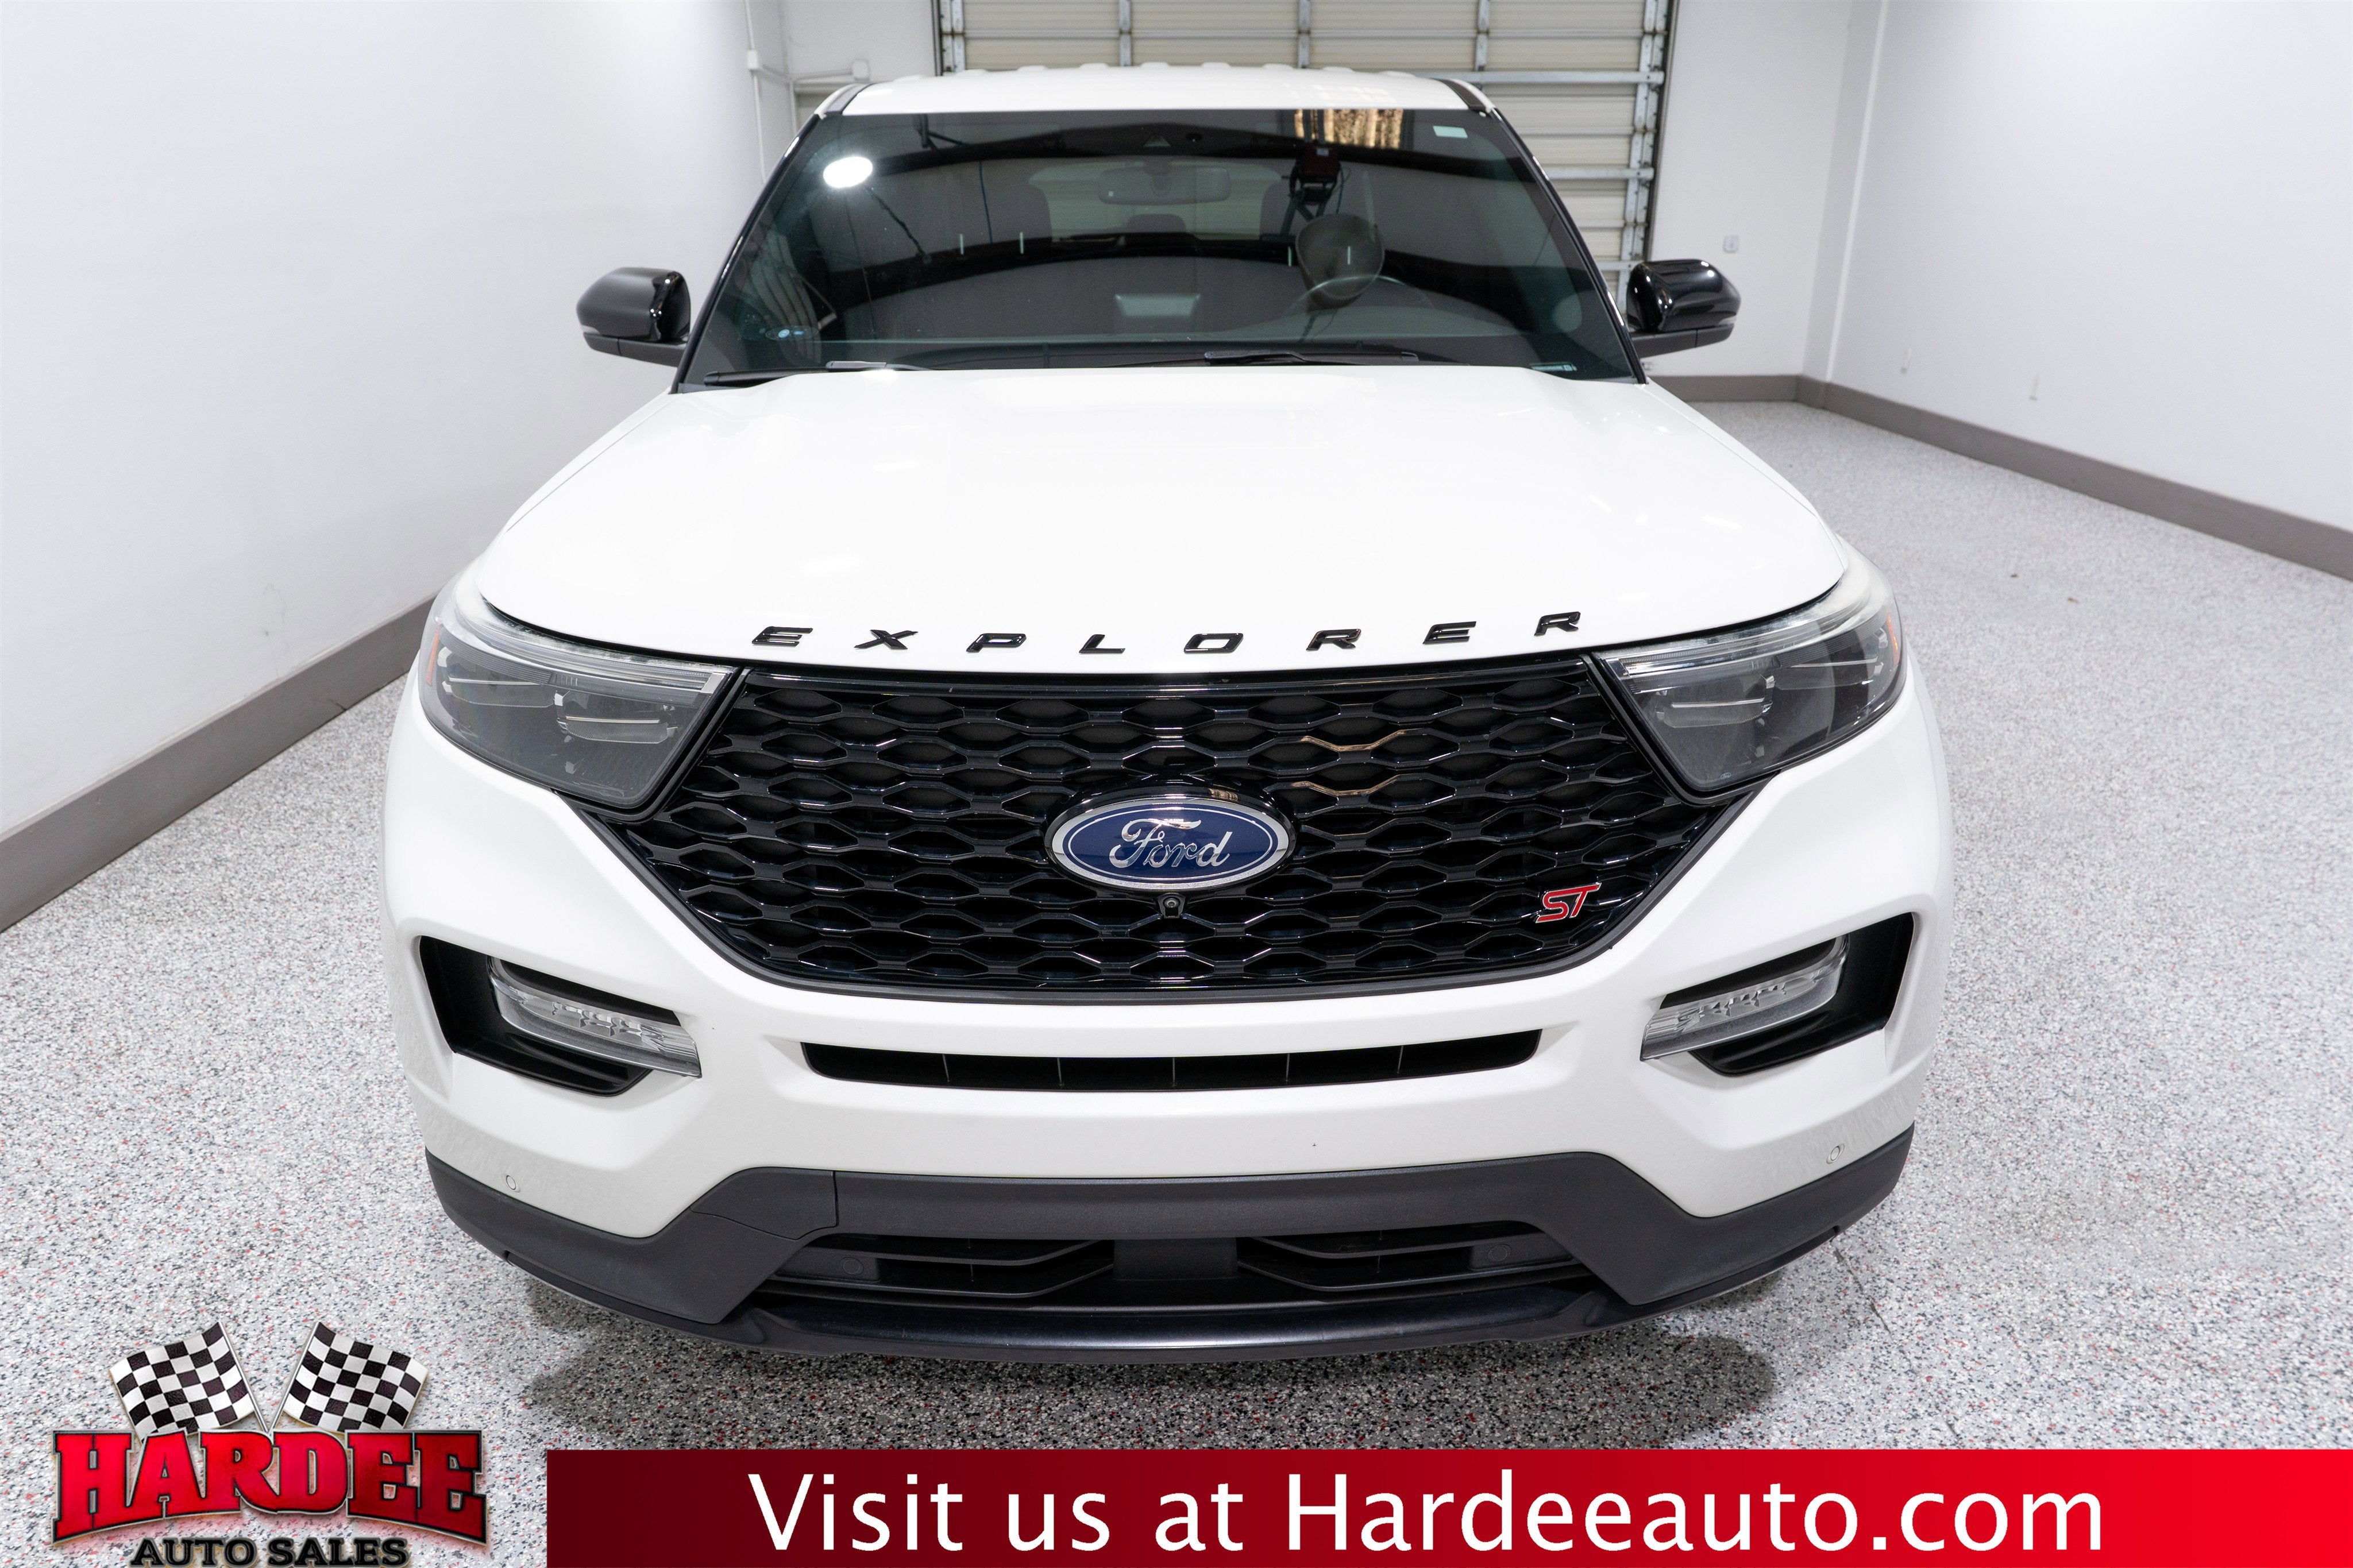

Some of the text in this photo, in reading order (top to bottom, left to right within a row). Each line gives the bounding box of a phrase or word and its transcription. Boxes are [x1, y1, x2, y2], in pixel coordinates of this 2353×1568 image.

[751, 611, 1581, 654] EXPLORER
[1109, 818, 1233, 868] Ford
[1534, 882, 1602, 924] ST
